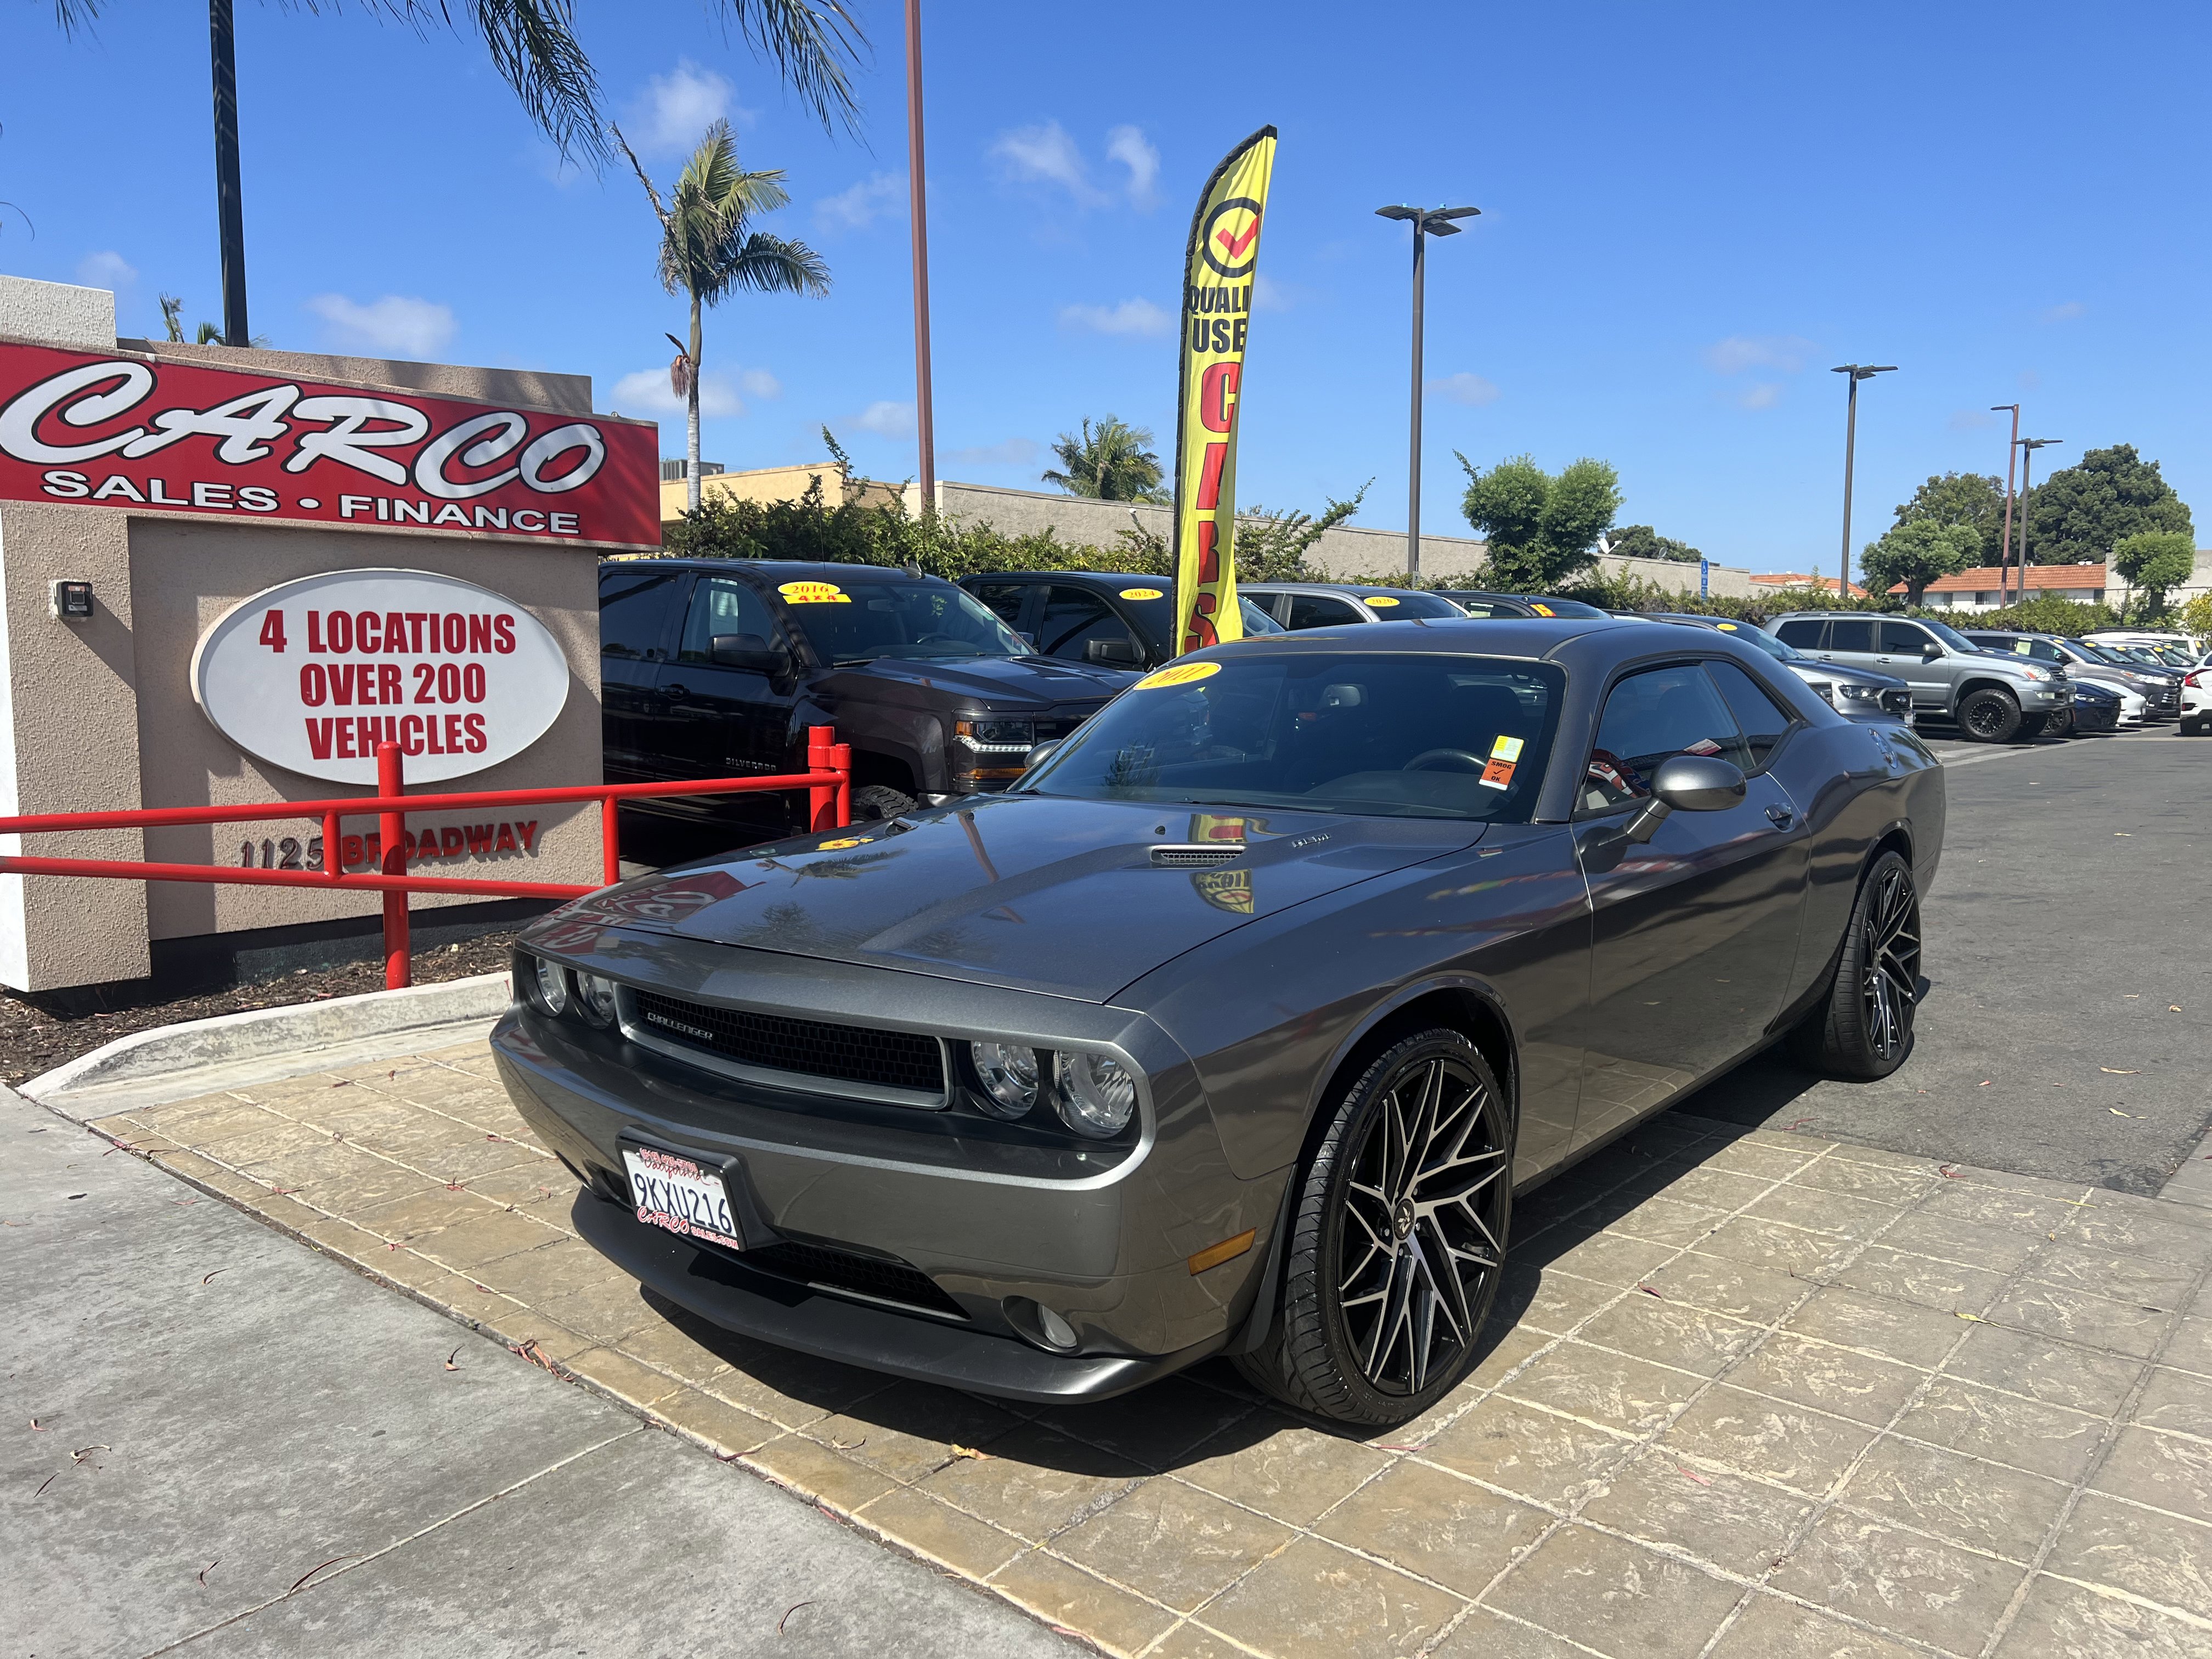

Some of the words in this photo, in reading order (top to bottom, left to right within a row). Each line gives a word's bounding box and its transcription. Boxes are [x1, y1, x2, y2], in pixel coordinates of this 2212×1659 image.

[0, 360, 607, 499] CARCO
[42, 470, 279, 511] SALES
[339, 494, 580, 535] FINANCE
[792, 585, 828, 594] 2016
[259, 610, 287, 653] 4
[307, 611, 516, 654] LOCATIONS
[300, 663, 402, 707] OVER
[413, 663, 486, 704] 200
[305, 713, 487, 759] VEHICLES
[725, 757, 776, 771] SILVERADO
[1491, 761, 1512, 770] SMOG
[241, 836, 324, 870] 1125
[647, 1012, 713, 1041] CHALLENGER
[634, 1173, 732, 1234] 9KXU216
[637, 1206, 690, 1234] CARCO
